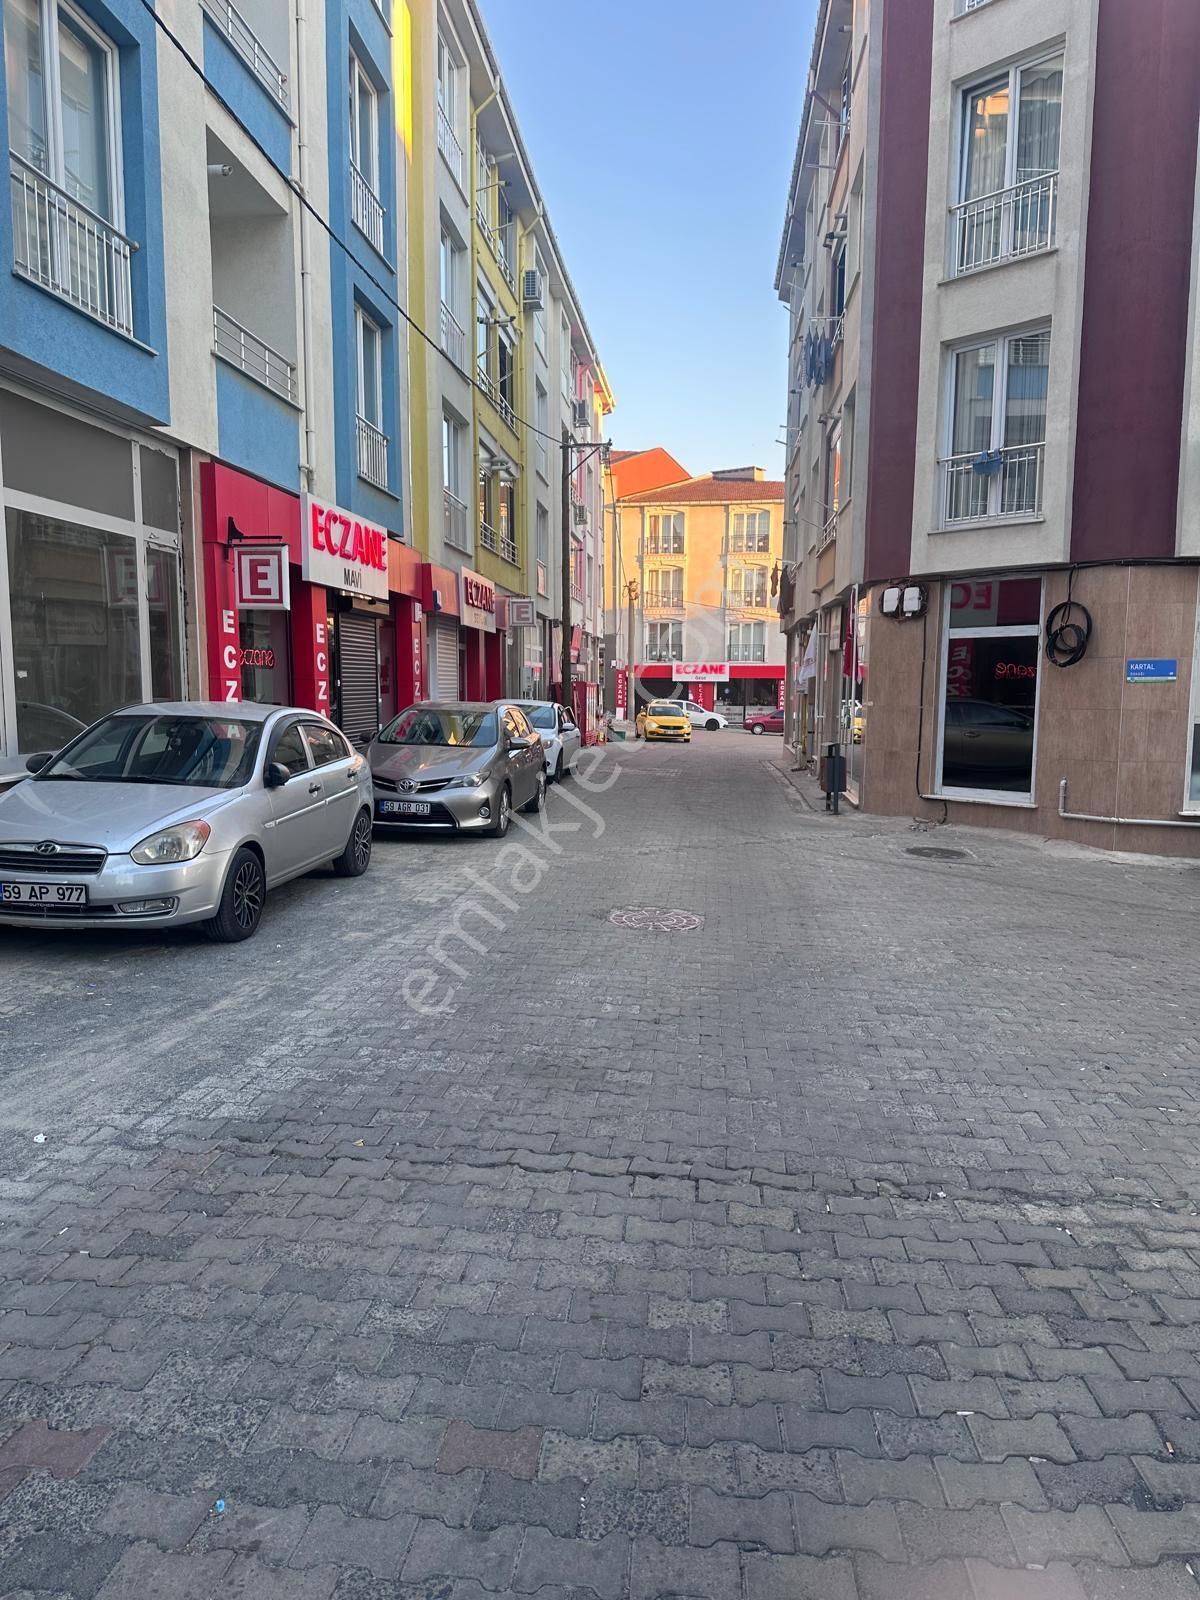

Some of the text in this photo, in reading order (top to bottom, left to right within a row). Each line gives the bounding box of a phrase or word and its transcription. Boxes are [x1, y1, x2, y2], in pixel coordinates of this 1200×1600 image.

[311, 502, 387, 571] ECZANE
[249, 559, 271, 595] E
[343, 568, 362, 589] MAVİ
[464, 576, 496, 614] ECZANE
[515, 604, 530, 621] E
[675, 664, 726, 675] ECZANE
[1130, 663, 1156, 671] KARTAL
[384, 801, 429, 813] 59 AGR 031
[2, 885, 84, 902] 59 AP 977
